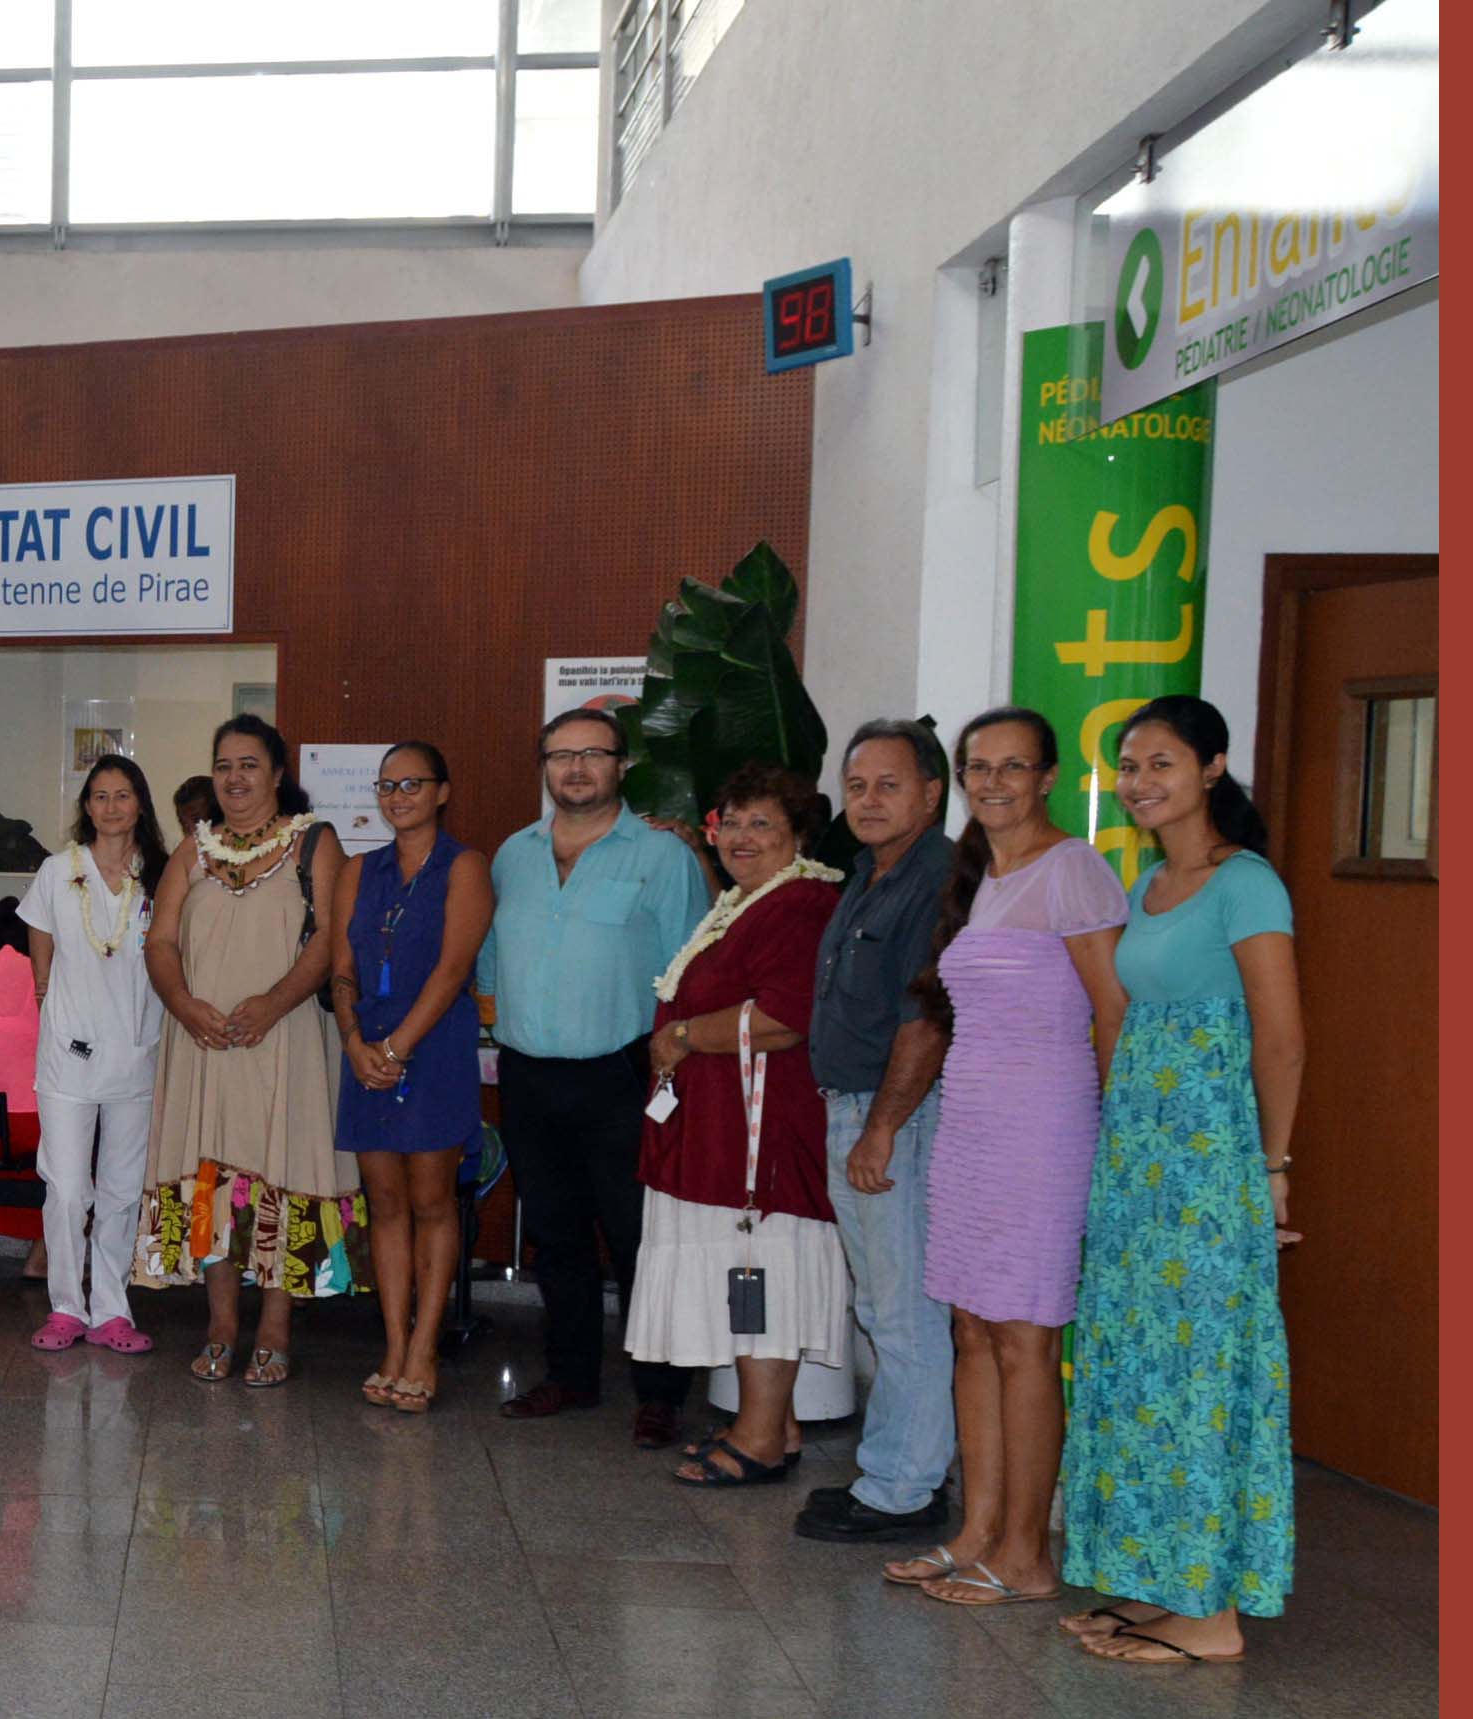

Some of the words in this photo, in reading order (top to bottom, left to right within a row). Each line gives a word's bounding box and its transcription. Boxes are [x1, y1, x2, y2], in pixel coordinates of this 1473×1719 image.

[778, 283, 833, 350] 98
[85, 503, 211, 561] CIVIL
[92, 573, 126, 604] de
[138, 572, 210, 603] Pirae
